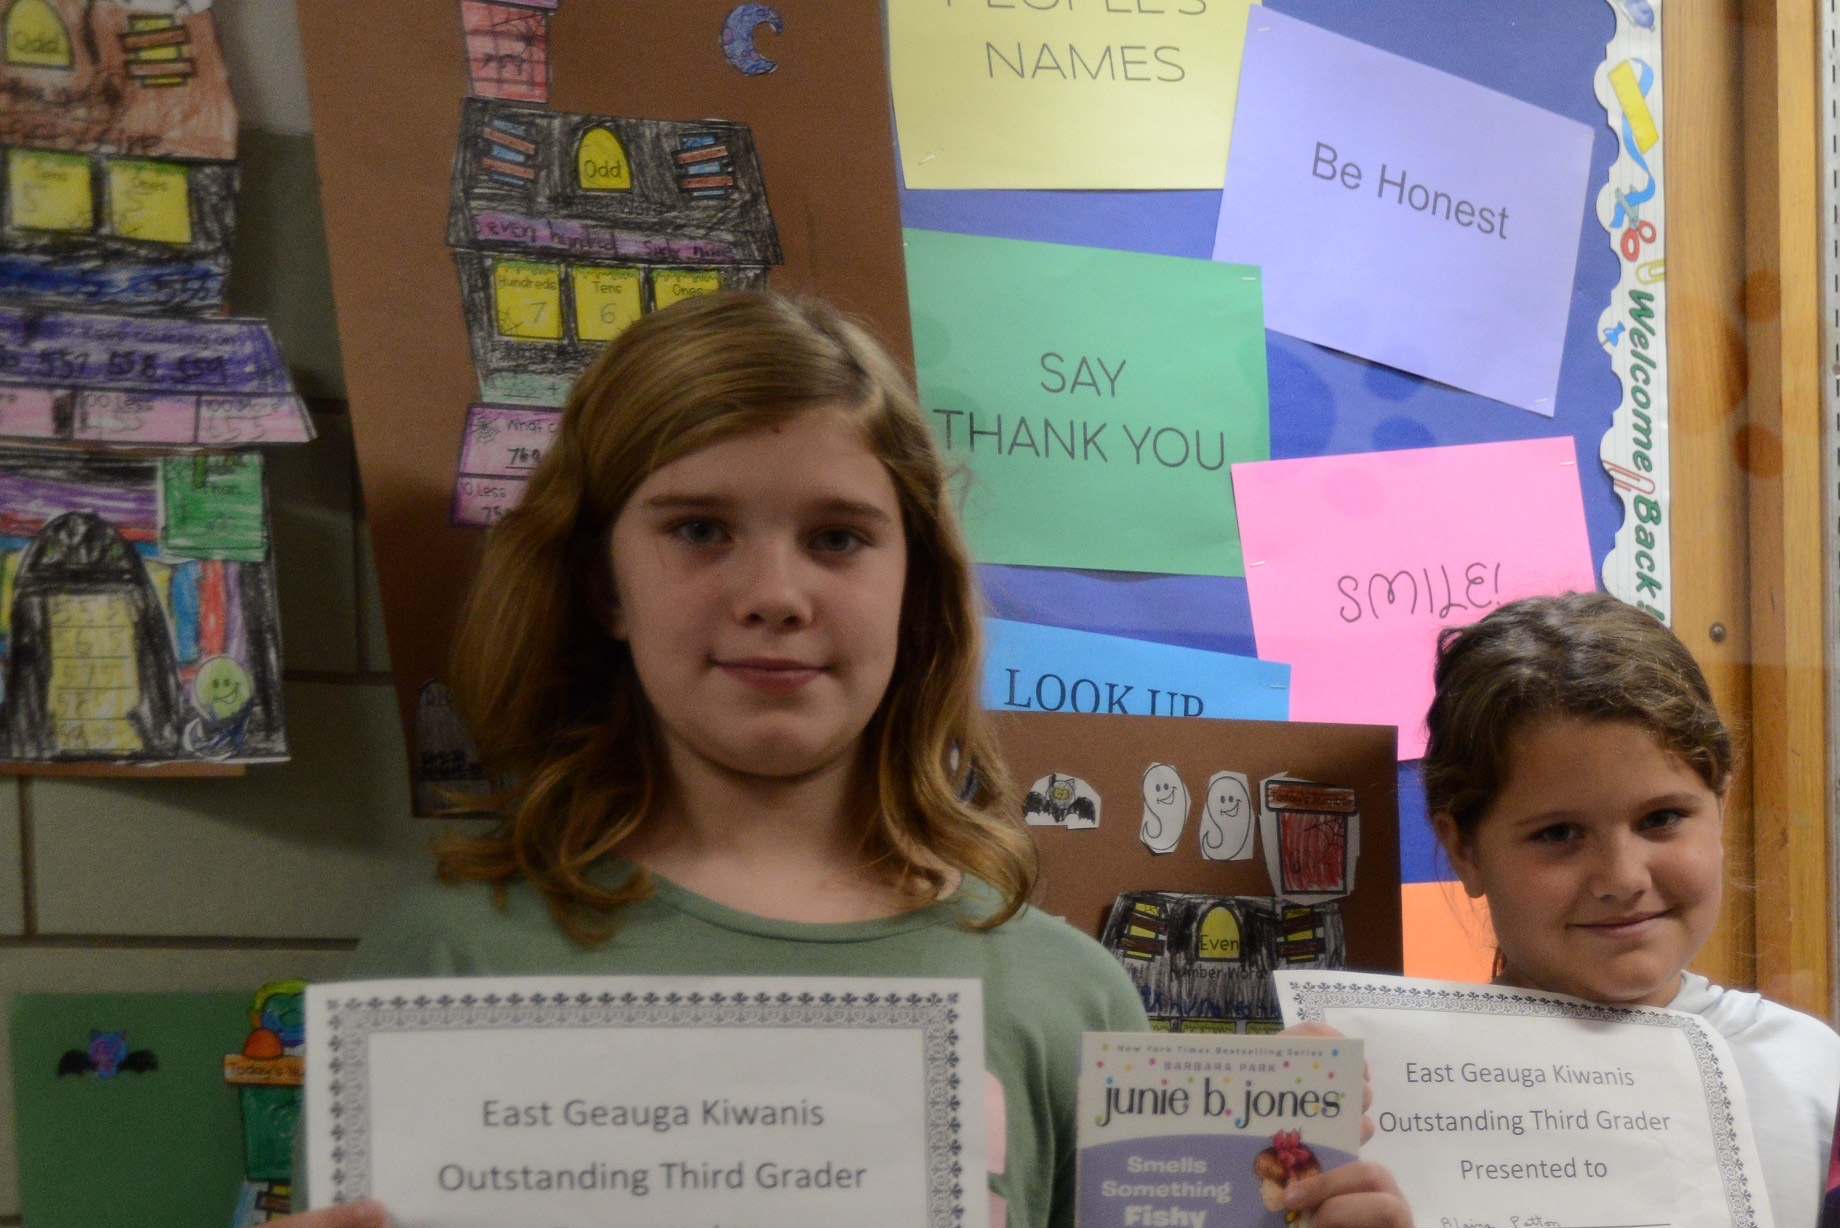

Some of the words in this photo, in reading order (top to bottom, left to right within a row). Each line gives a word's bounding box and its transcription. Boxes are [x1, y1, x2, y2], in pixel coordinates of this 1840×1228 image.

[985, 41, 1187, 83] NAMES
[584, 159, 621, 179] Odd
[1311, 141, 1363, 191] Be
[1377, 164, 1510, 241] Honest
[592, 280, 622, 295] Tens
[530, 301, 547, 323] 7
[600, 302, 616, 324] 6
[1040, 352, 1126, 399] SAY
[1628, 289, 1657, 472] Welcome
[933, 409, 1107, 464] THANK
[1123, 425, 1227, 473] YOU
[1633, 494, 1665, 621] Back!
[1004, 668, 1134, 715] LOOK
[1200, 933, 1240, 952] Even
[1163, 1060, 1232, 1072] BARBARA
[1239, 1062, 1277, 1073] PARK
[1406, 1062, 1454, 1085] East
[1462, 1063, 1547, 1088] Geauga
[1553, 1064, 1635, 1088] Kiwanis
[482, 1101, 553, 1128] East
[563, 1100, 689, 1132] Geauga
[702, 1098, 825, 1127] Kiwanis
[1096, 1076, 1190, 1127] junie
[1233, 1078, 1341, 1129] jones
[1379, 1109, 1524, 1136] Outstanding
[1530, 1108, 1590, 1132] Third
[1596, 1110, 1670, 1133] Grader
[438, 1163, 650, 1196] Outstanding
[659, 1160, 744, 1189] Third
[755, 1160, 867, 1190] Grader
[1127, 1156, 1207, 1174] Smells
[1460, 1157, 1577, 1180] Presented
[1584, 1159, 1608, 1179] to
[1101, 1179, 1232, 1204] Something
